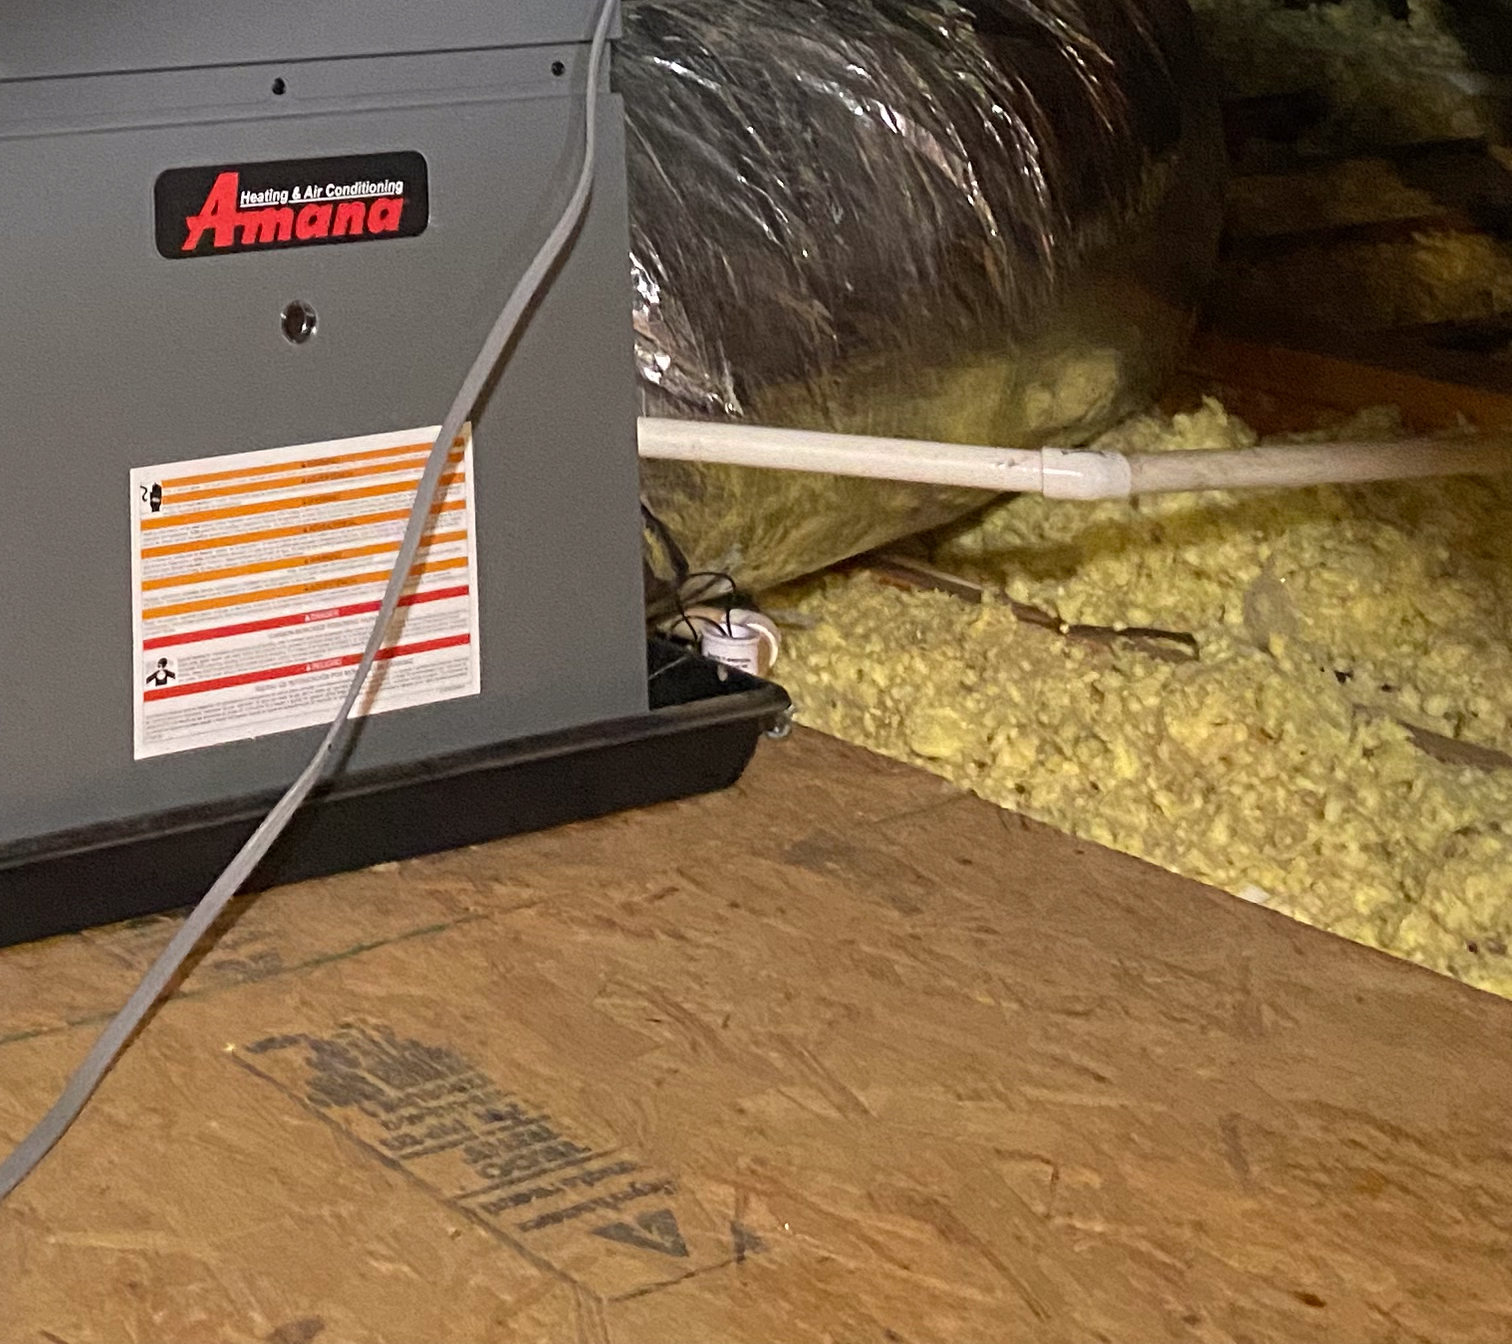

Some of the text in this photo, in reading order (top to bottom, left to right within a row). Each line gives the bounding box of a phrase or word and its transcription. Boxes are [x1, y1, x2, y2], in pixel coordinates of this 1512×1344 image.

[181, 172, 404, 251] Amana
[240, 179, 404, 206] Heating & Air Conditioning
